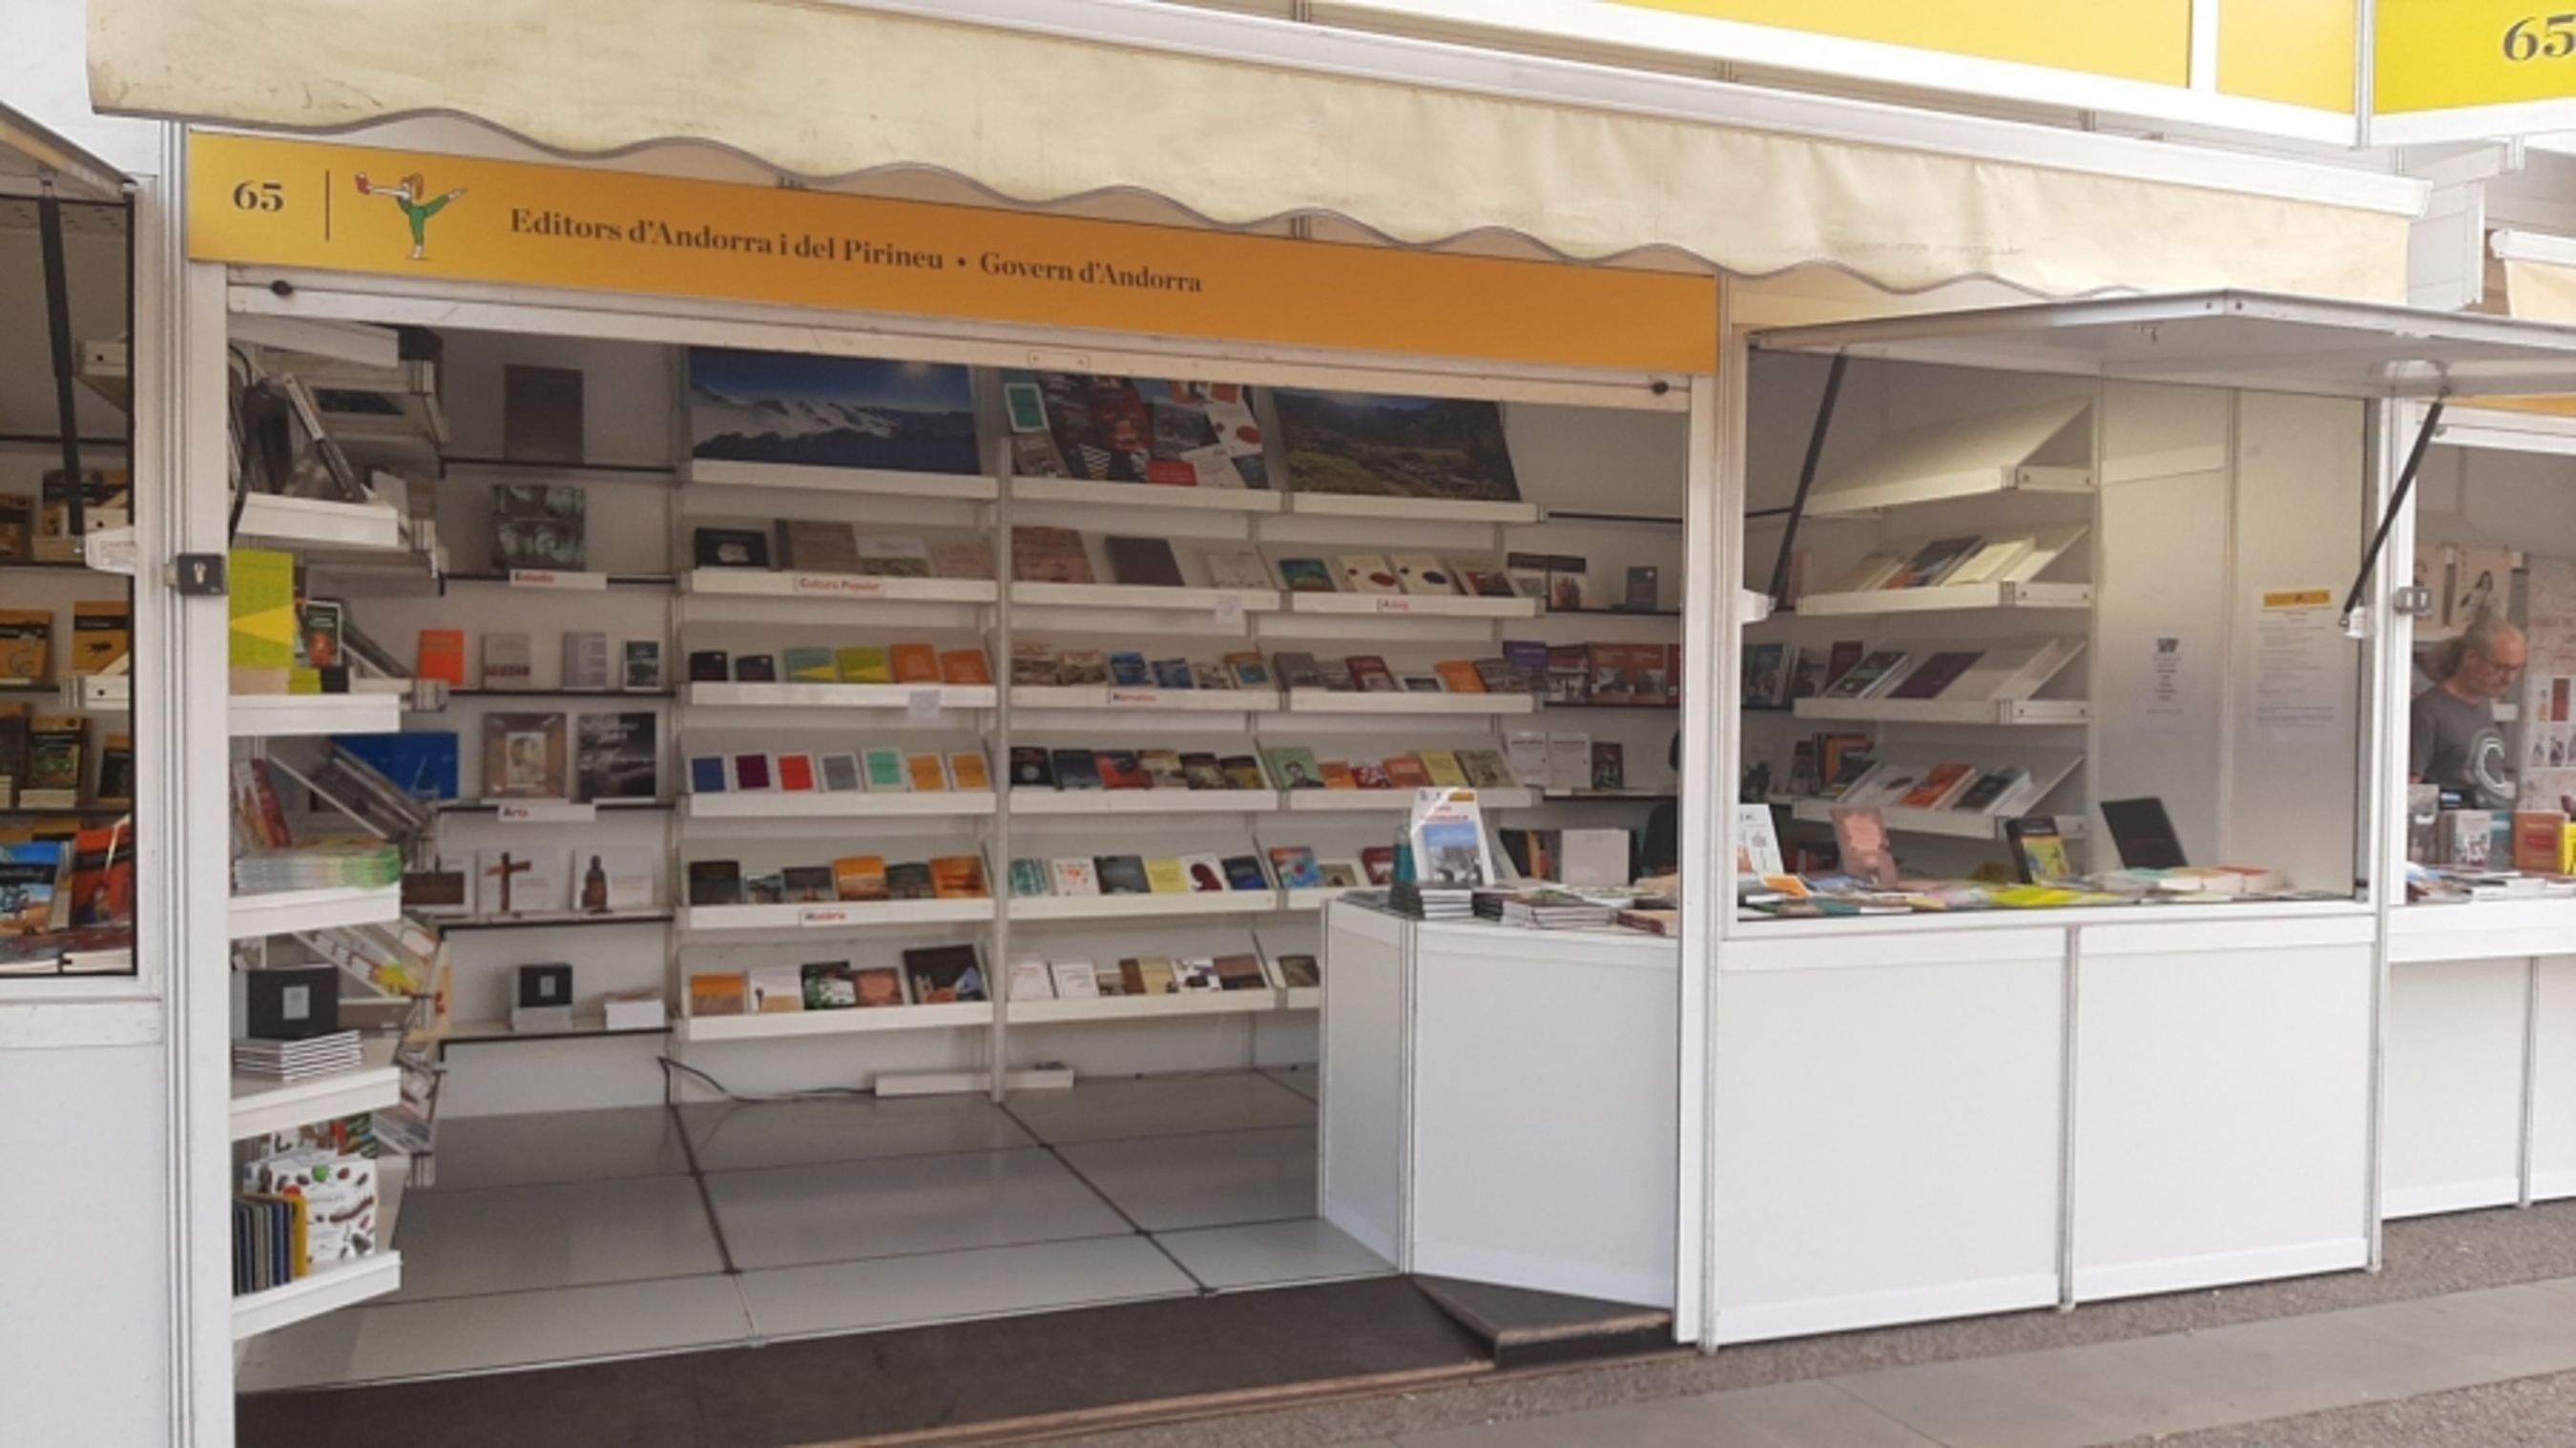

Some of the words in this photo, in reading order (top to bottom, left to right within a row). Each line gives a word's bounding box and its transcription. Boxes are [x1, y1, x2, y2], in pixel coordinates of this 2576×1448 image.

[2503, 13, 2576, 62] 65
[233, 179, 284, 212] 65
[510, 208, 622, 240] Editors
[628, 218, 772, 255] d'Andorra
[779, 233, 788, 256] i
[794, 235, 836, 259] del
[843, 238, 944, 271] Pirineu
[979, 251, 1074, 282] Govern
[1079, 260, 1203, 293] d'Andorra
